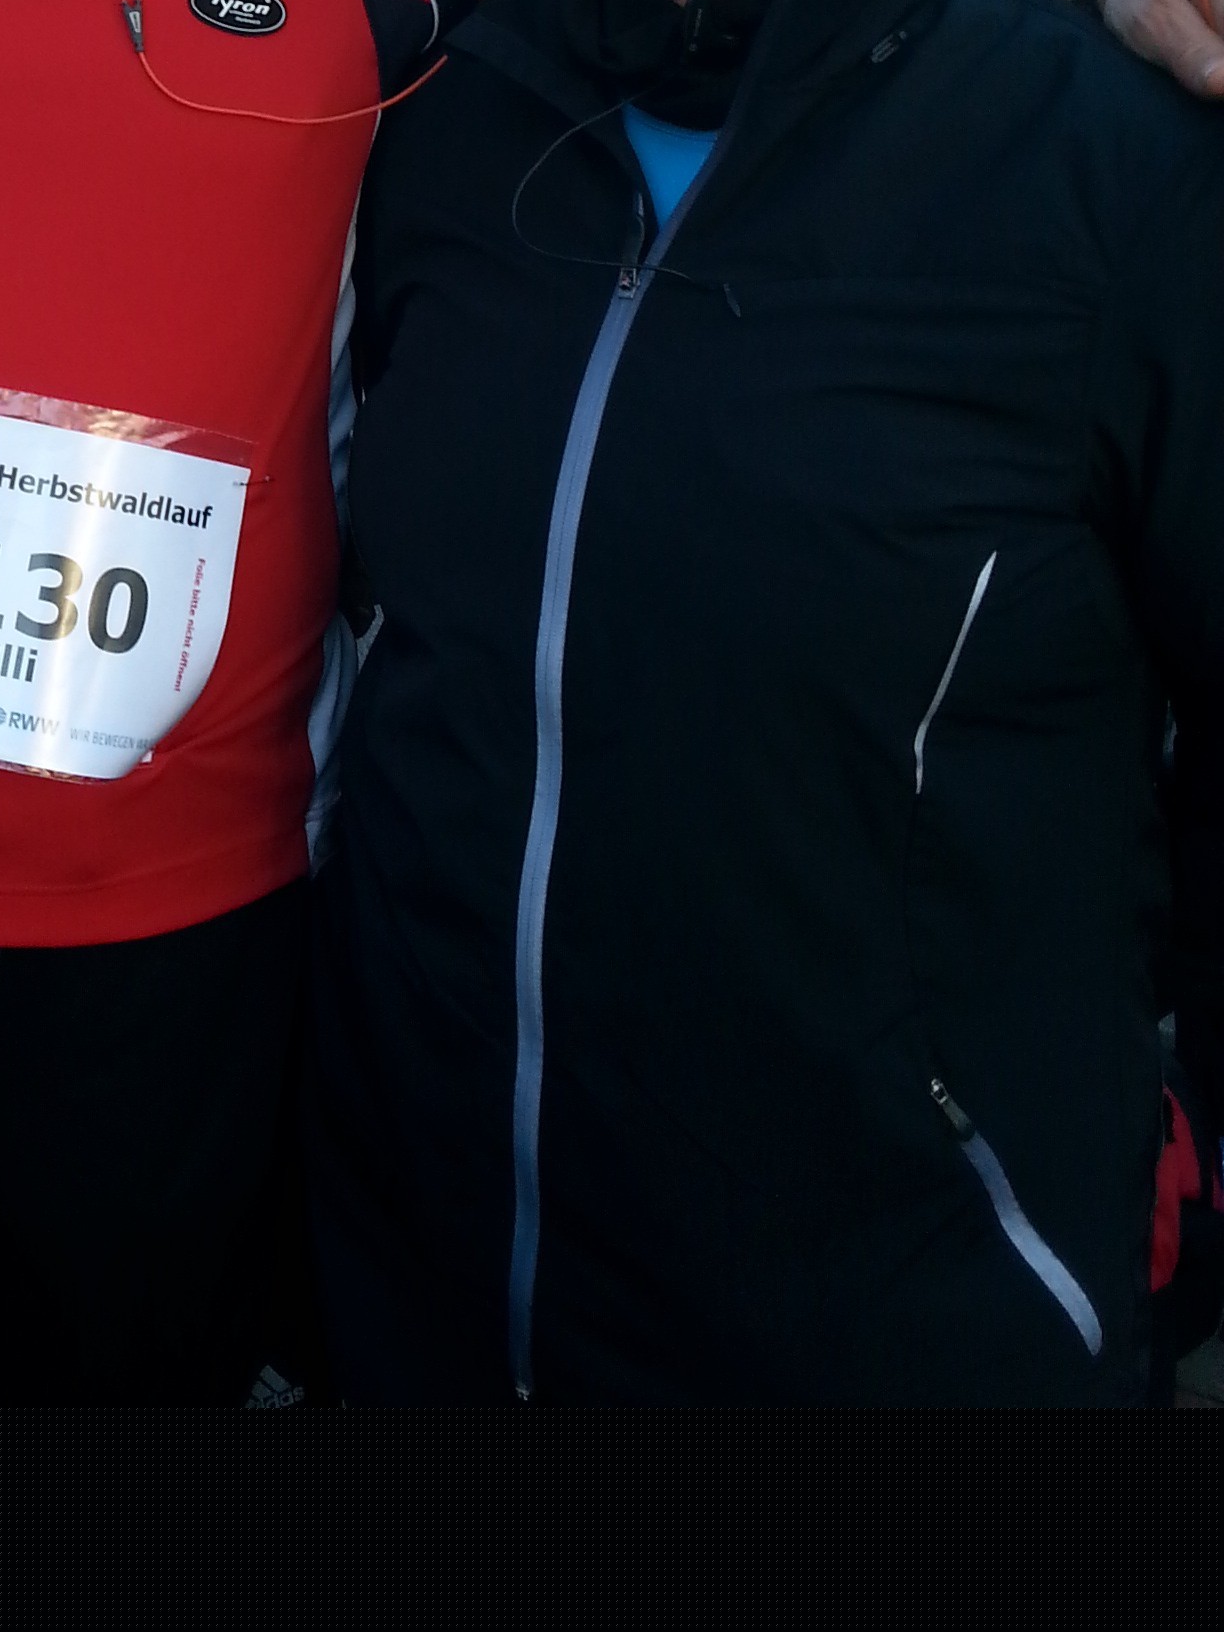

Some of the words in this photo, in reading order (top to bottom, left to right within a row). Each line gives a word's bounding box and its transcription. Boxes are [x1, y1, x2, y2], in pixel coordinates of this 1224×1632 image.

[193, 556, 207, 587] Folie
[188, 588, 202, 617] bitte
[182, 619, 195, 648] nicht
[8, 711, 60, 736] RWW
